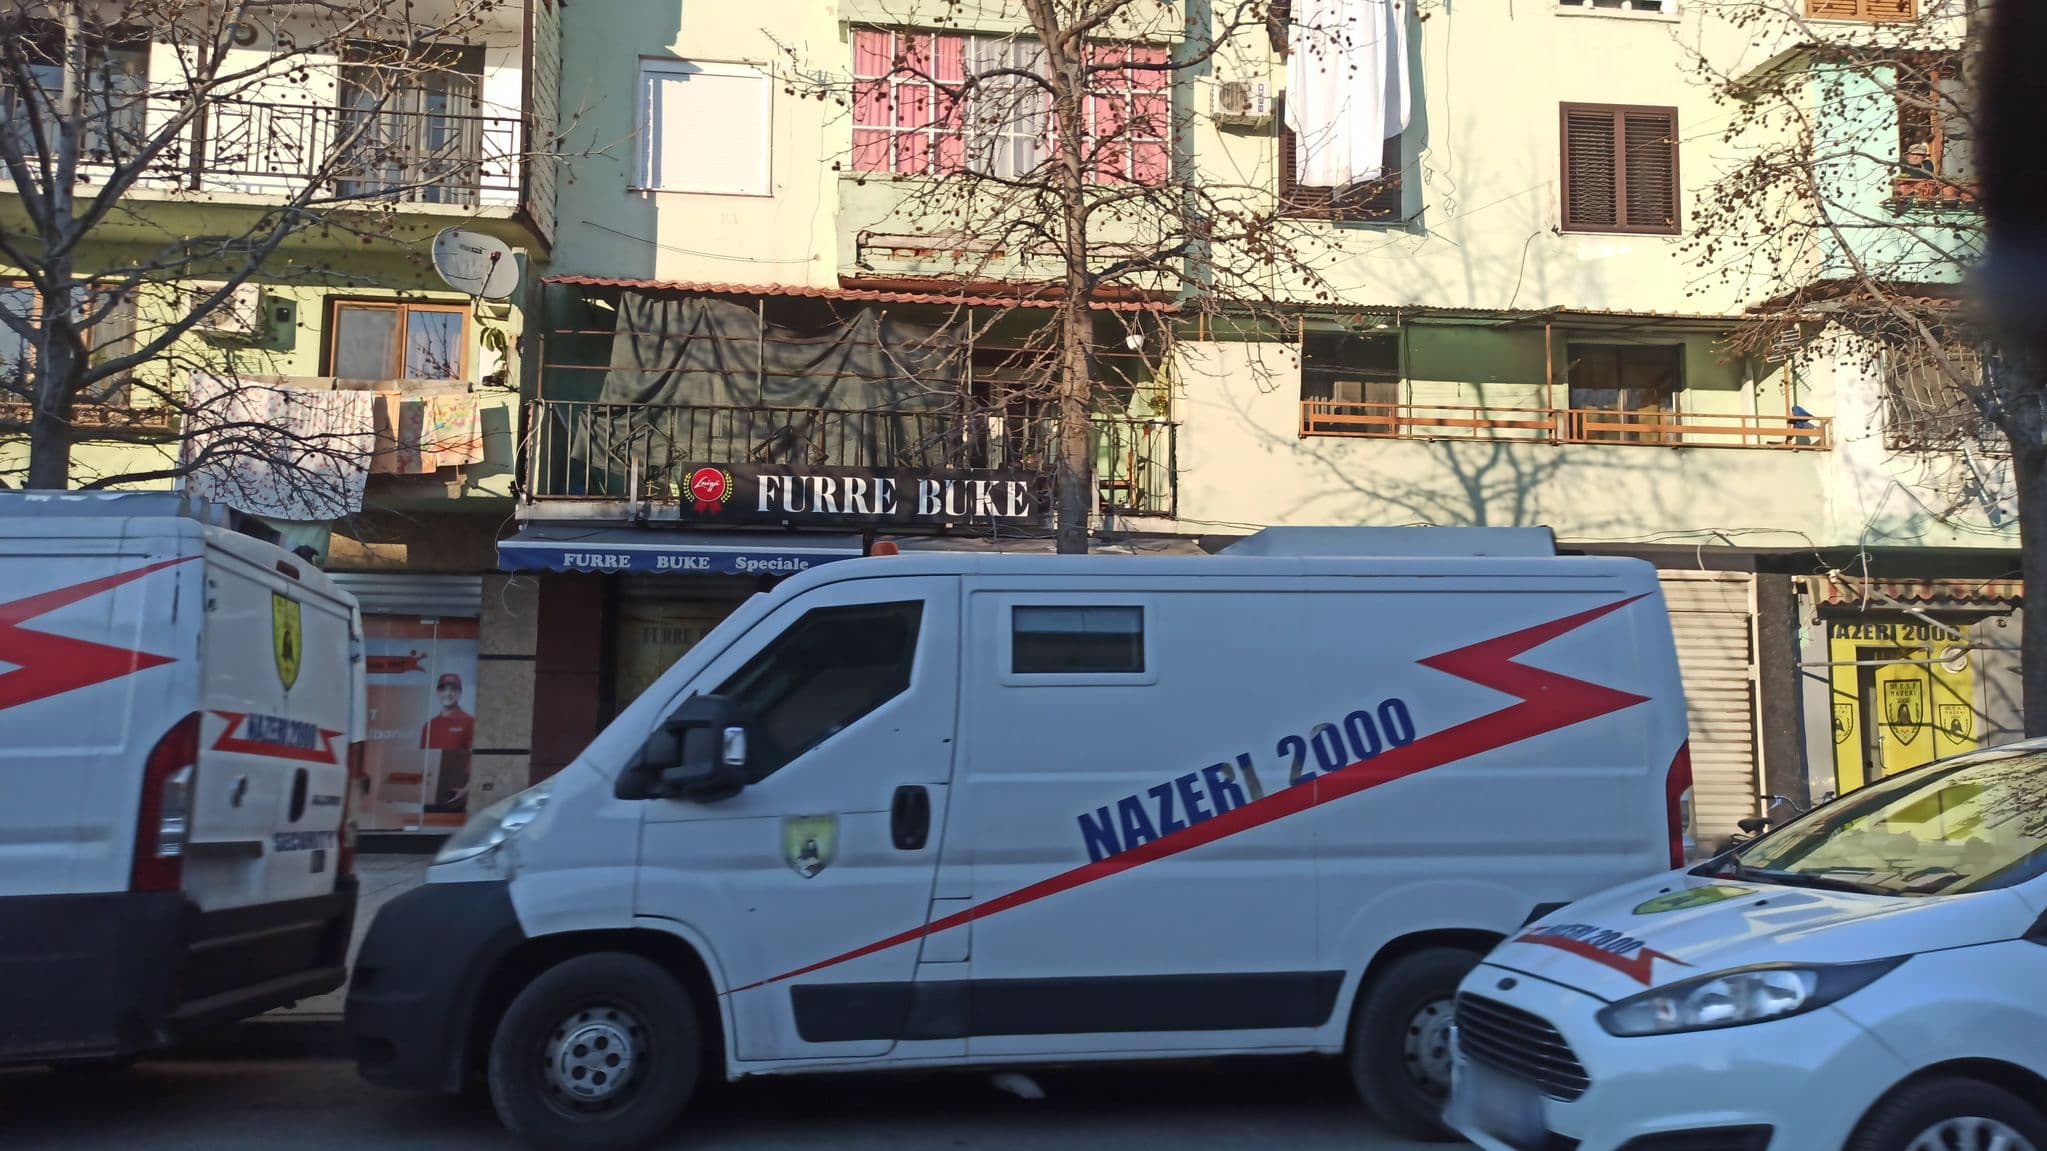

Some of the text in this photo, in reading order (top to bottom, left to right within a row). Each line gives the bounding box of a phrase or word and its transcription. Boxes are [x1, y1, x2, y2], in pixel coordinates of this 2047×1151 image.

[755, 473, 1030, 519] FURRE BUKE
[563, 552, 809, 574] FURRE BUKE Speciale
[1077, 696, 1416, 864] NAZERI 2000
